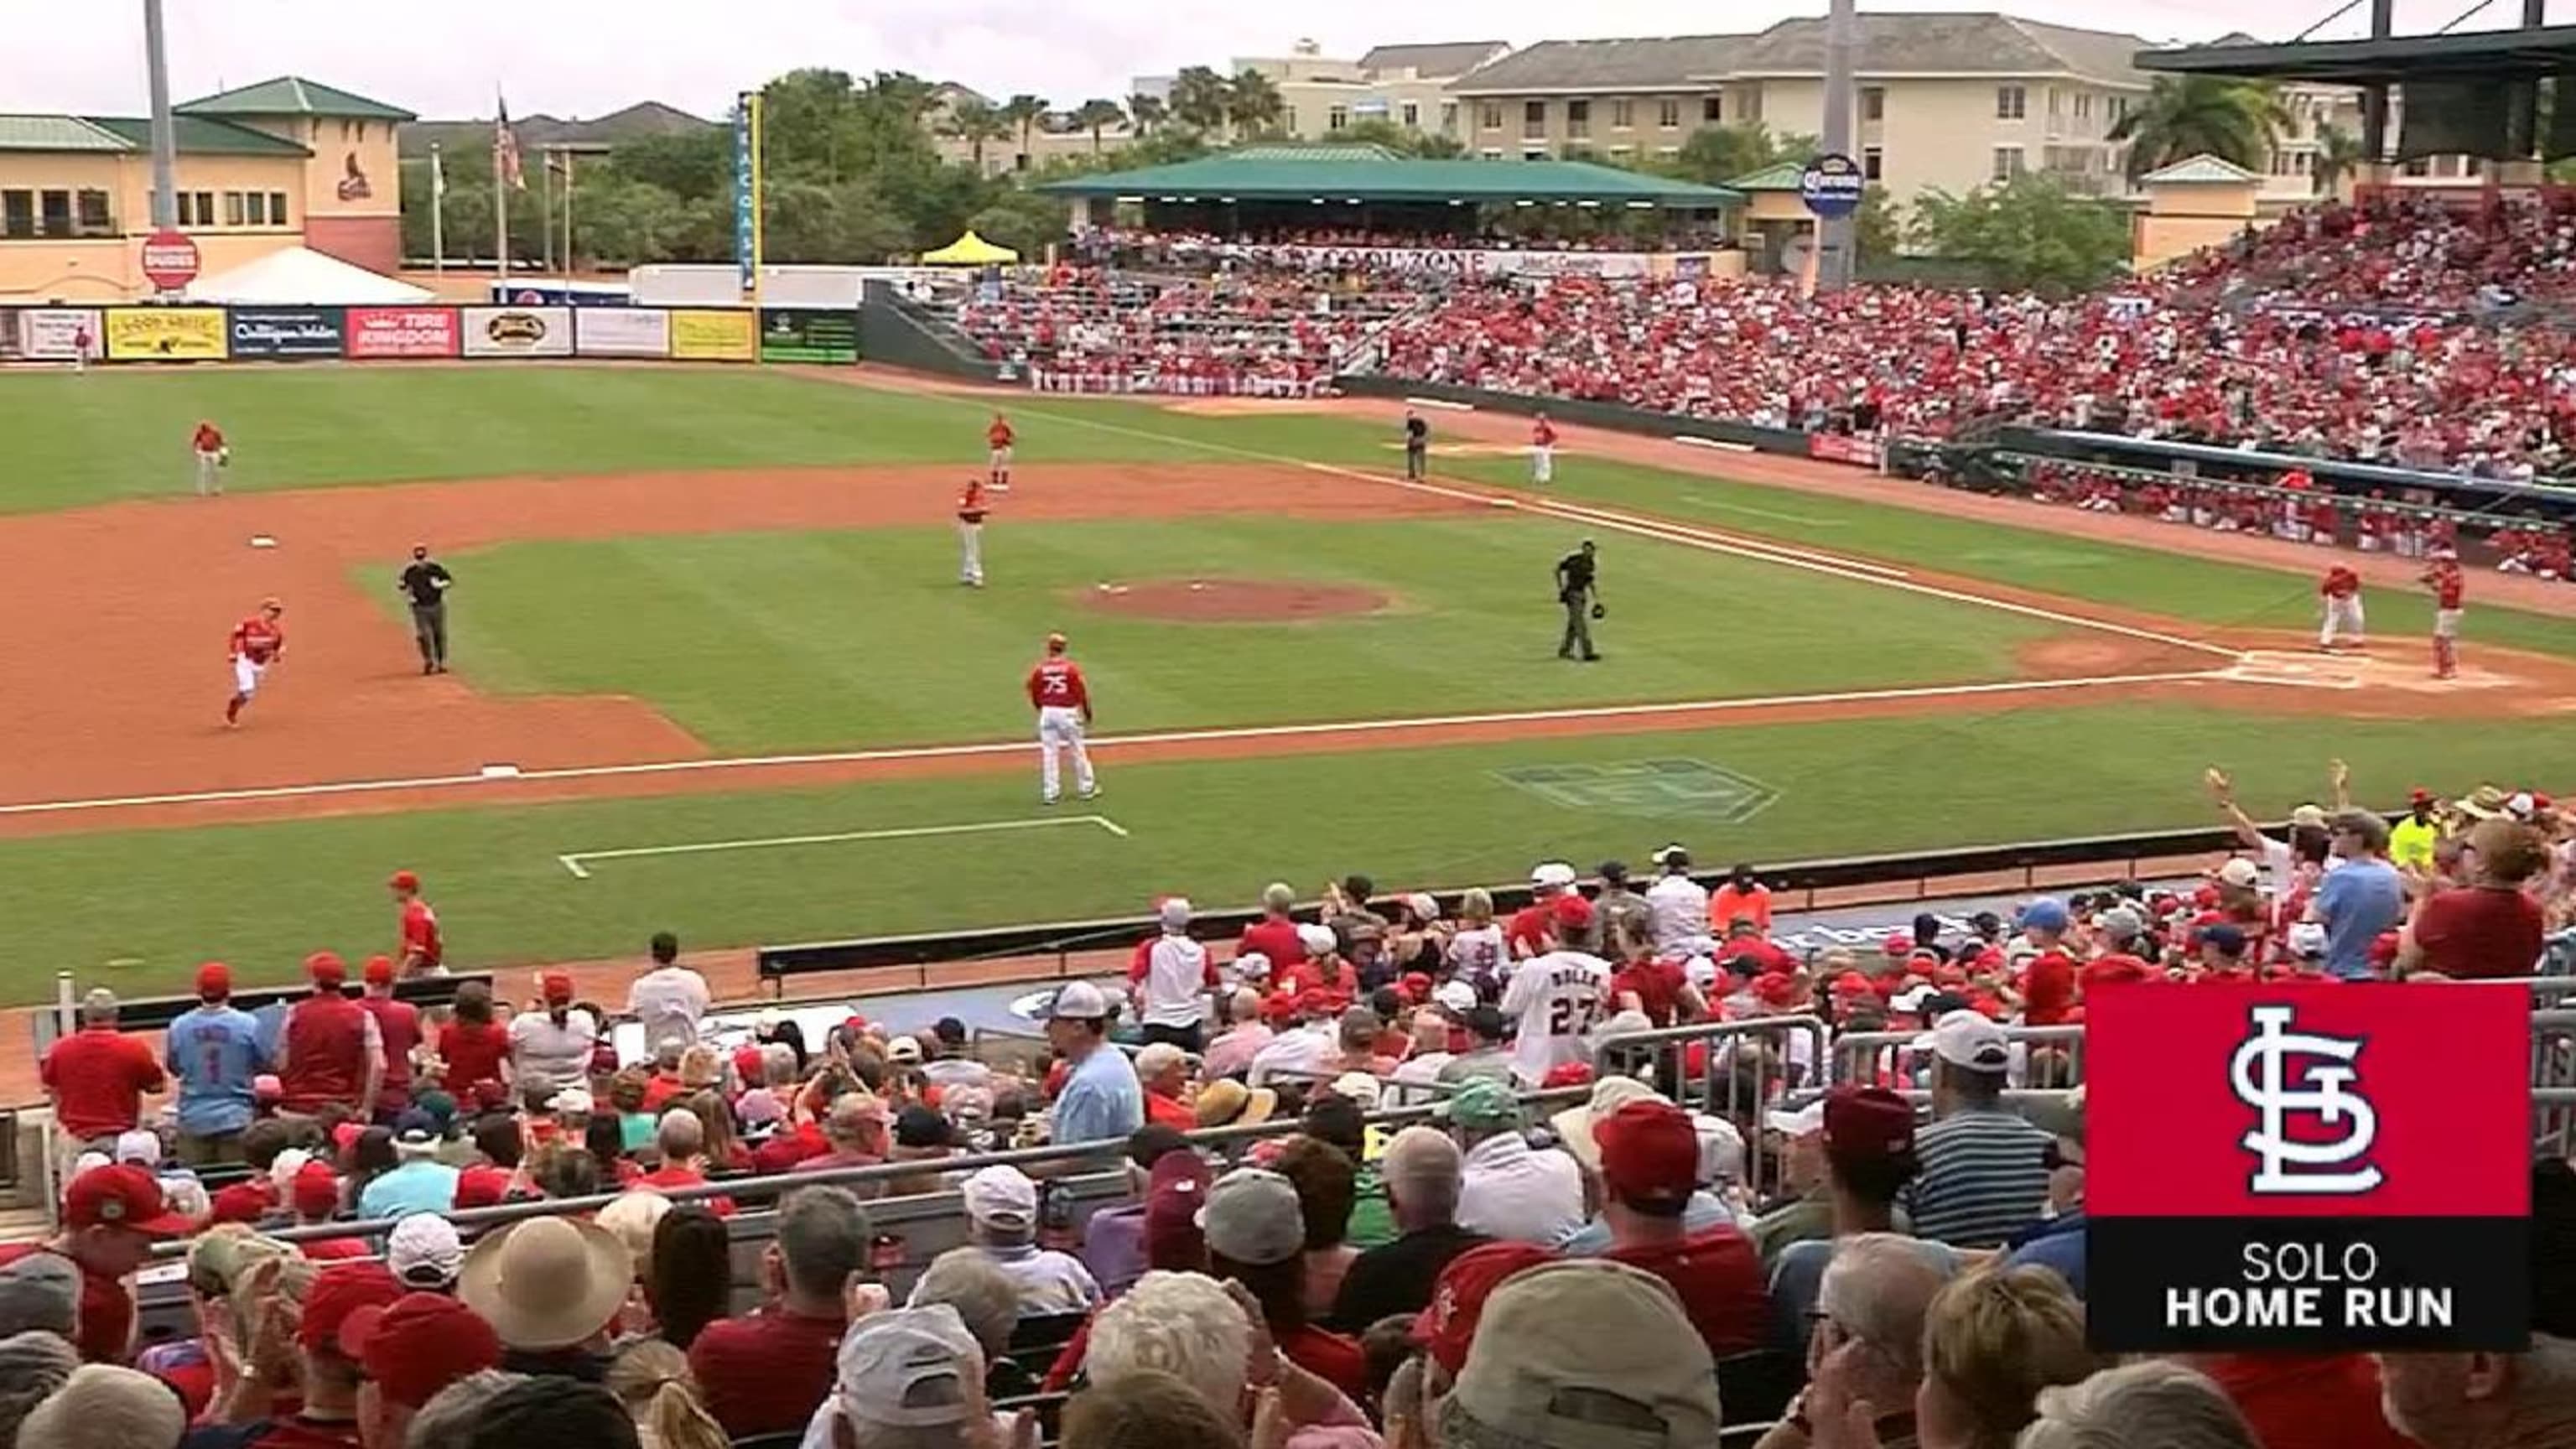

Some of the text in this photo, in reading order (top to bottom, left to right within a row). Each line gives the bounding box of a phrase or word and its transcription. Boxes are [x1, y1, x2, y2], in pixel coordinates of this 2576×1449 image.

[403, 312, 449, 328] TIRE
[356, 328, 450, 345] KINGDOM
[1042, 675, 1067, 694] 75
[1550, 997, 1598, 1036] 27
